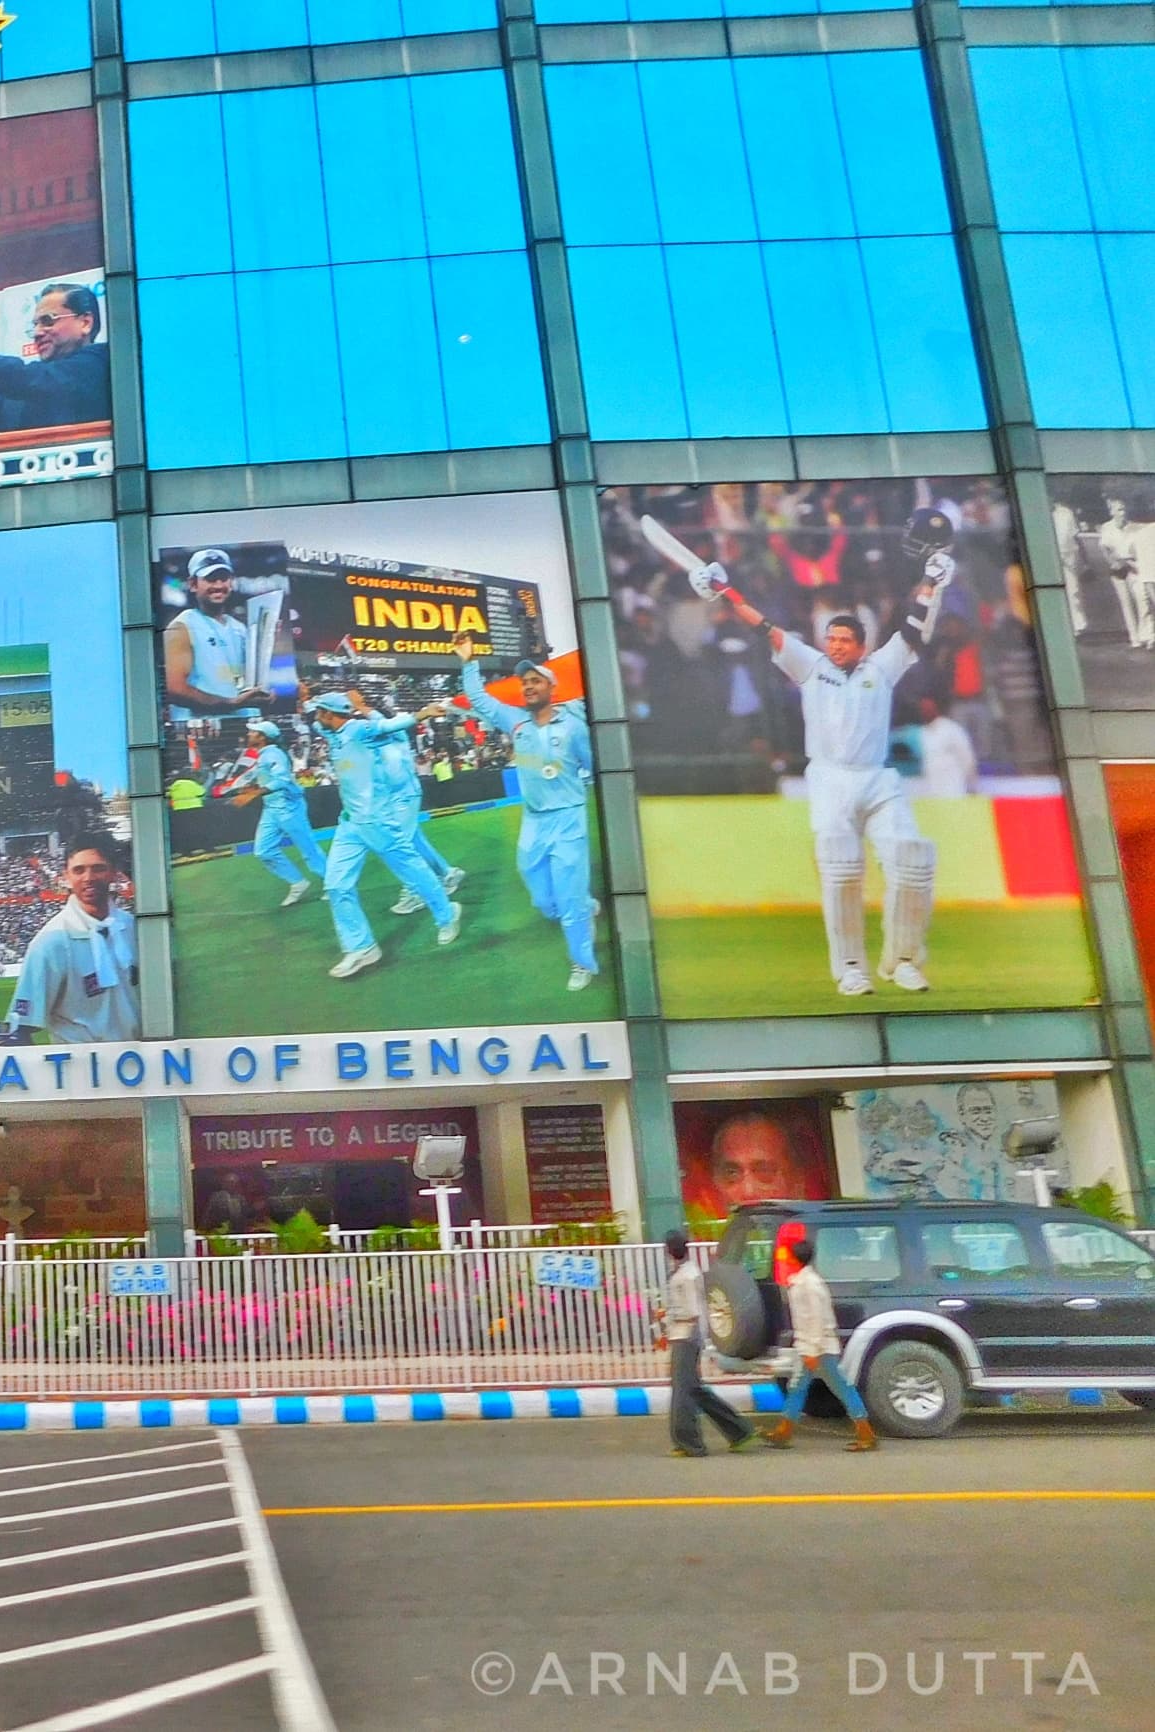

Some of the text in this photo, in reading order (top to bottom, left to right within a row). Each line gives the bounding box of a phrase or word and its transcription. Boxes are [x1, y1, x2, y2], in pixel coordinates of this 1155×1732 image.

[346, 575, 478, 598] CONGRATULATION
[352, 595, 489, 634] INDIA
[353, 638, 389, 652] T20
[227, 1043, 301, 1083] OF
[335, 1032, 610, 1080] BENGAL
[201, 1129, 293, 1151] TRIBUTE
[305, 1127, 335, 1147] TO
[347, 1126, 362, 1145] A
